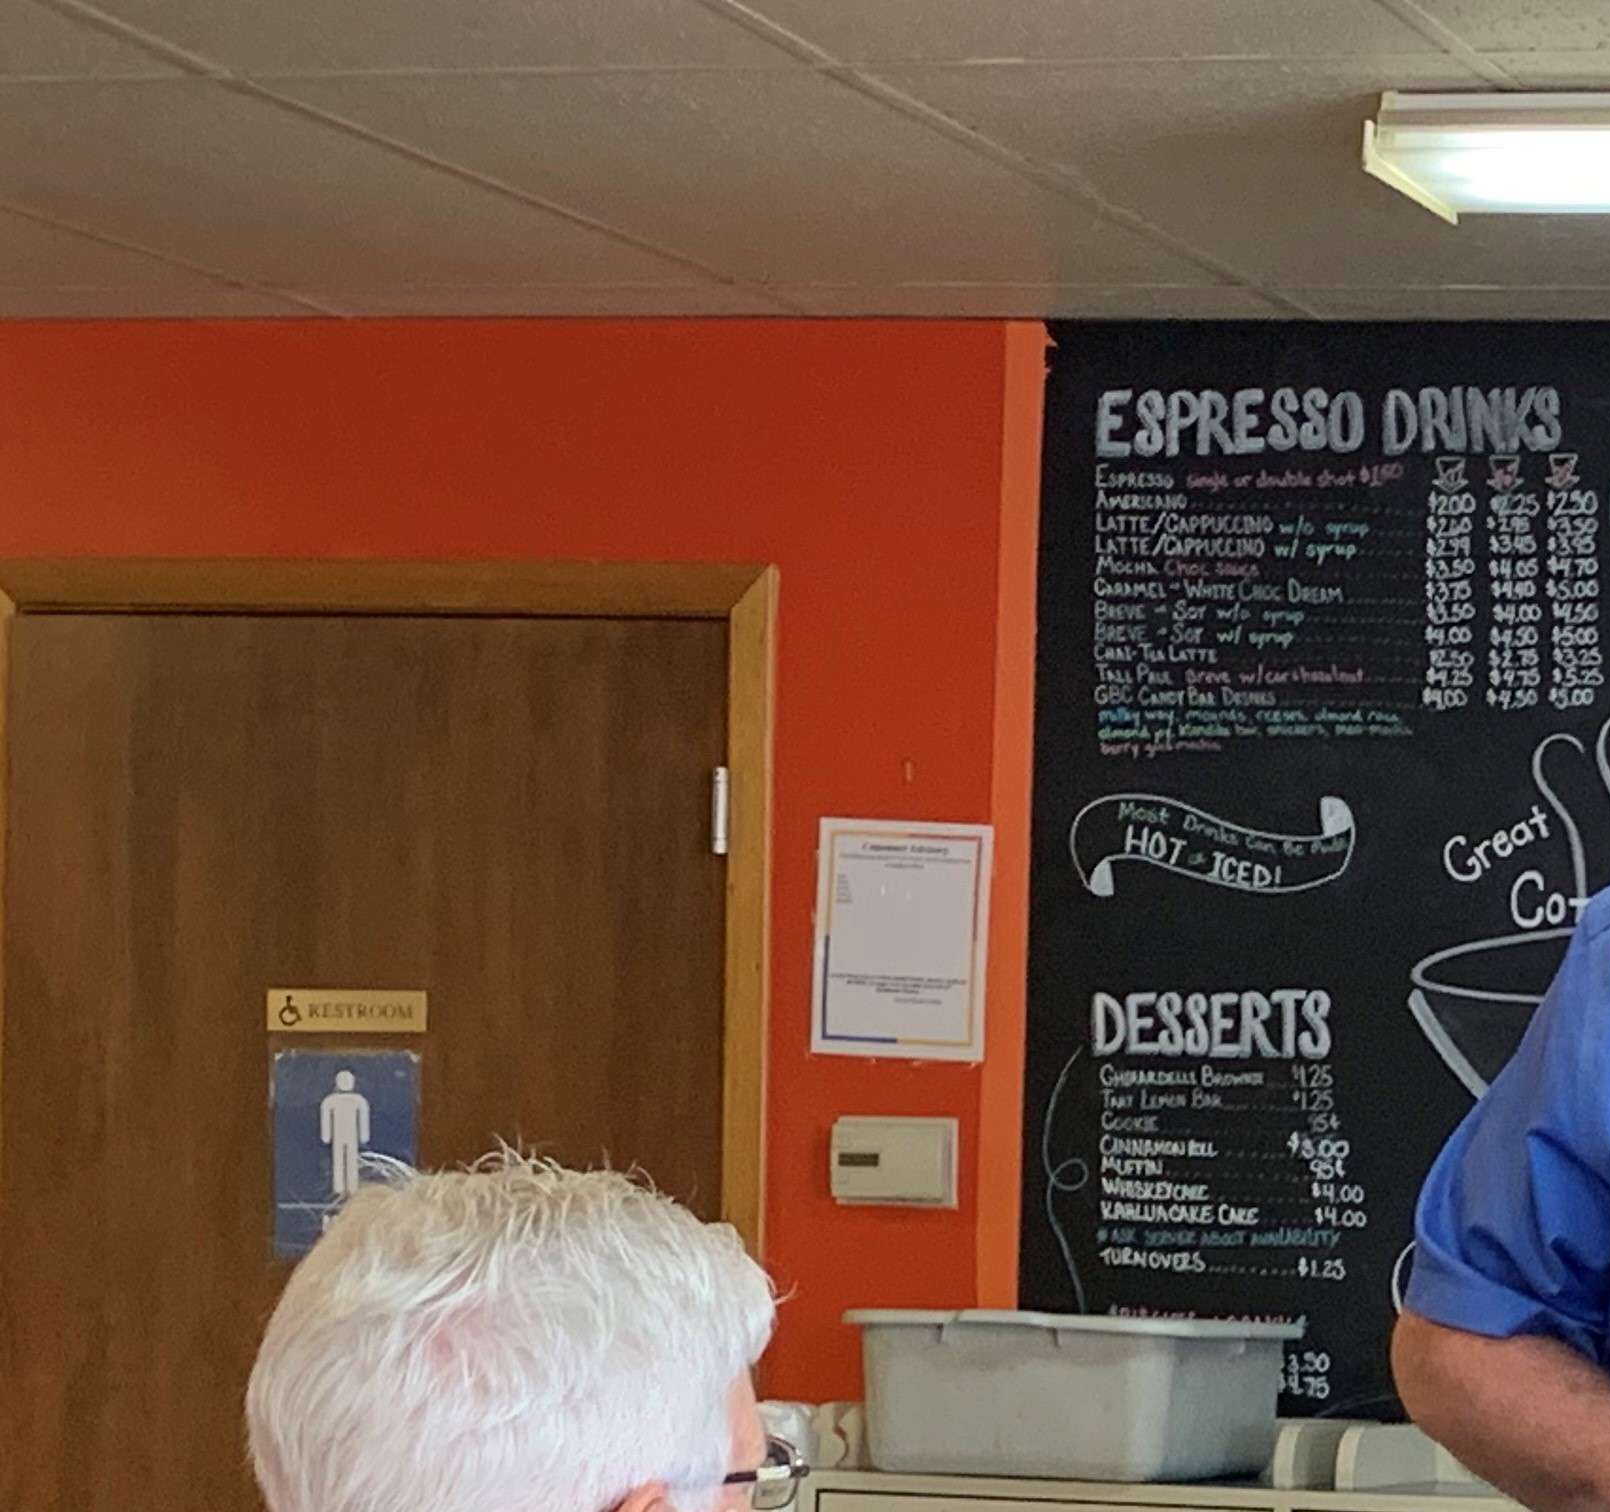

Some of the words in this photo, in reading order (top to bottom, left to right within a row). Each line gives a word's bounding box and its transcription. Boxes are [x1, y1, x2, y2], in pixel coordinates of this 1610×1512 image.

[1096, 388, 1365, 456] ESPRESSO
[1383, 386, 1562, 454] DRINKS
[1095, 464, 1174, 488] ESPRESSO
[1096, 490, 1187, 509] AMERICANO
[1306, 543, 1356, 565] syrup
[1096, 556, 1157, 576] MOCHA
[1094, 578, 1167, 598] CARAMEL
[1248, 631, 1294, 649] syrup
[1118, 802, 1170, 825] Most
[1444, 804, 1550, 882] Great
[1125, 824, 1187, 865] HOT
[1208, 851, 1282, 887] ICED!
[309, 1003, 413, 1020] RESTROOM
[1092, 989, 1331, 1059] DESSERTS
[1101, 1111, 1160, 1132] COOKIE
[1101, 1157, 1163, 1176] MUFFIN
[1311, 1182, 1364, 1203] $4.00
[1315, 1207, 1366, 1226] $4.00
[1100, 1247, 1206, 1273] TURNOVERS
